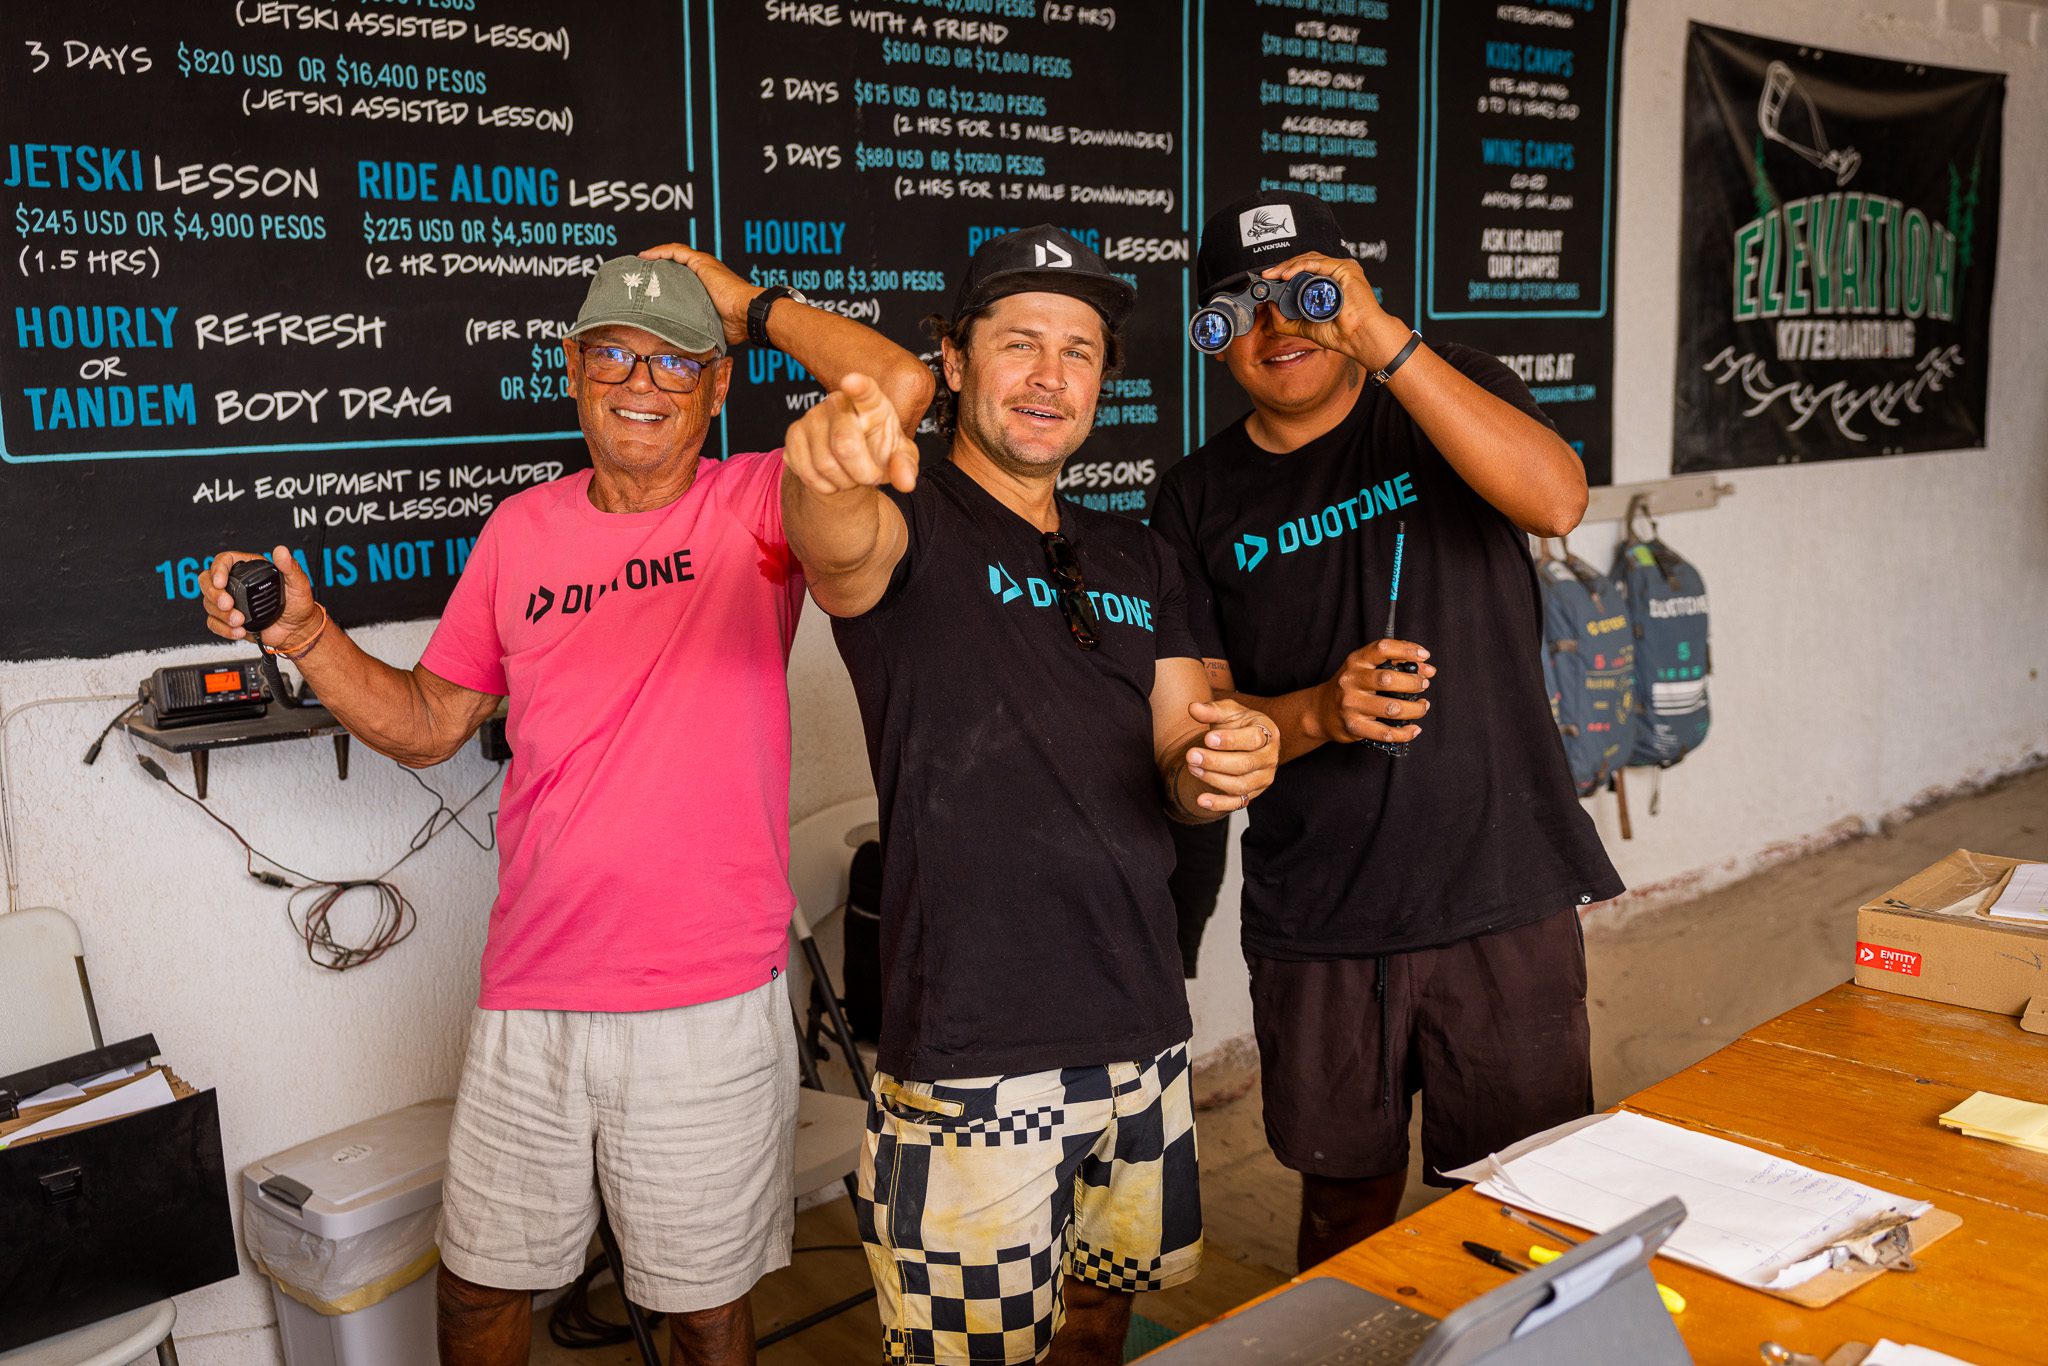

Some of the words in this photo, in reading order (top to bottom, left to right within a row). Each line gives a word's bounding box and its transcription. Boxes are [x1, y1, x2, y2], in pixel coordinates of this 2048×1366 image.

[236, 0, 338, 31] (JETSKI
[345, 11, 467, 40] ASSISTED
[474, 24, 569, 60] LESSON)
[765, 0, 842, 27] SHARE
[850, 10, 906, 34] WITH
[911, 16, 927, 37] A
[933, 18, 1009, 45] FRIEND
[1078, 6, 1117, 32] HRS)
[1295, 20, 1326, 38] KITE
[1327, 24, 1361, 44] ONLY
[25, 41, 49, 73] 3
[64, 40, 152, 75] DAYS
[178, 41, 235, 78] $820
[242, 54, 283, 78] USD
[299, 57, 326, 83] OR
[337, 53, 418, 88] $16,400
[427, 67, 487, 94] PESOS
[882, 36, 921, 66] $600
[924, 45, 950, 67] USD
[954, 47, 972, 68] OR
[1033, 55, 1072, 79] PESOS
[1356, 45, 1388, 67] PESOS
[1486, 40, 1522, 71] KIDS
[1523, 44, 1574, 78] CAMPS
[1287, 66, 1332, 87] BOARD
[1332, 72, 1365, 91] ONLY
[243, 88, 342, 116] (JETSKI
[351, 96, 469, 125] ASSISTED
[478, 106, 573, 136] LESSON)
[760, 77, 775, 99] 2
[784, 77, 839, 104] DAYS
[893, 85, 920, 107] USD
[927, 87, 947, 108] OR
[1007, 94, 1047, 117] PESOS
[1348, 91, 1379, 112] PESOS
[894, 112, 913, 137] (2
[917, 117, 952, 136] HRS
[957, 119, 993, 138] FOR
[1000, 122, 1021, 141] 1.5
[1026, 125, 1066, 144] MILE
[1068, 127, 1173, 155] DOWNWINDER)
[1282, 115, 1368, 138] ACCESSORIES
[763, 145, 777, 173] 3
[786, 143, 841, 169] DAYS
[855, 141, 893, 172] $880
[897, 149, 923, 170] USD
[931, 151, 950, 172] OR
[1006, 154, 1046, 177] PESOS
[1346, 139, 1378, 159] PESOS
[1481, 137, 1523, 168] WING
[1524, 139, 1575, 171] CAMPS
[4, 144, 143, 192] JETSKI
[154, 154, 319, 199] LESSON
[358, 160, 438, 202] RIDE
[450, 164, 559, 207] ALONG
[569, 178, 694, 212] LESSON
[1288, 163, 1347, 182] WETSUIT
[894, 175, 915, 200] (2
[919, 179, 954, 198] HRS
[958, 179, 993, 199] FOR
[1000, 182, 1022, 200] 1.5
[1027, 182, 1066, 202] MILE
[1069, 185, 1174, 214] DOWNWINDER)
[1346, 183, 1378, 203] PESOS
[16, 202, 77, 239] $245
[85, 210, 127, 237] USD
[137, 211, 167, 237] OR
[174, 207, 254, 241] $4,900
[261, 214, 326, 240] PESOS
[363, 211, 412, 244] $225
[419, 219, 454, 243] USD
[461, 221, 486, 244] OR
[492, 216, 557, 248] $4,500
[563, 222, 618, 246] PESOS
[745, 219, 846, 256] HOURLY
[1104, 236, 1190, 263] LESSON
[1253, 246, 1263, 254] LA
[1263, 241, 1290, 252] VENTANA
[1481, 227, 1506, 252] ASK
[1506, 228, 1524, 253] US
[1524, 229, 1564, 253] ABOUT
[1732, 190, 1957, 322] ELEVATION
[19, 245, 78, 277] (1.5
[88, 246, 160, 278] HRS)
[366, 252, 392, 279] (2
[400, 253, 437, 277] HR
[1488, 254, 1514, 279] OUR
[1514, 254, 1559, 279] CAMPS!
[750, 265, 788, 289] $165
[792, 270, 820, 290] USD
[824, 269, 844, 290] OR
[847, 265, 899, 294] $3,300
[903, 271, 945, 291] PESOS
[15, 305, 178, 349] HOURLY
[195, 312, 386, 350] REFRESH
[466, 318, 520, 345] (PER
[527, 318, 577, 340] PRIV
[1776, 319, 1917, 361] KITEBOARDING
[79, 356, 127, 380] OR
[531, 342, 568, 372] $10
[1535, 353, 1556, 382] US
[1555, 353, 1576, 382] AT
[501, 376, 525, 401] OR
[530, 372, 569, 403] $2,0
[1115, 378, 1153, 398] PESOS
[24, 383, 197, 431] TANDEM
[215, 388, 328, 425] BODY
[339, 386, 452, 420] DRAG
[1121, 404, 1158, 424] PESOS
[193, 478, 244, 503] ALL
[255, 468, 412, 500] EQUIPMENT
[419, 468, 441, 491] IS
[449, 461, 563, 489] INCLUDED
[1056, 458, 1157, 490] LESSONS
[293, 506, 316, 529] IN
[324, 502, 386, 528] OUR
[390, 492, 493, 520] LESSONS
[1109, 490, 1147, 512] PESOS
[1278, 472, 1418, 555] DUOTONE
[323, 545, 357, 587] IS
[367, 540, 434, 583] NOT
[561, 549, 695, 614] DUONE
[1026, 577, 1154, 632] DTONE
[1880, 949, 1917, 965] ENTITY
